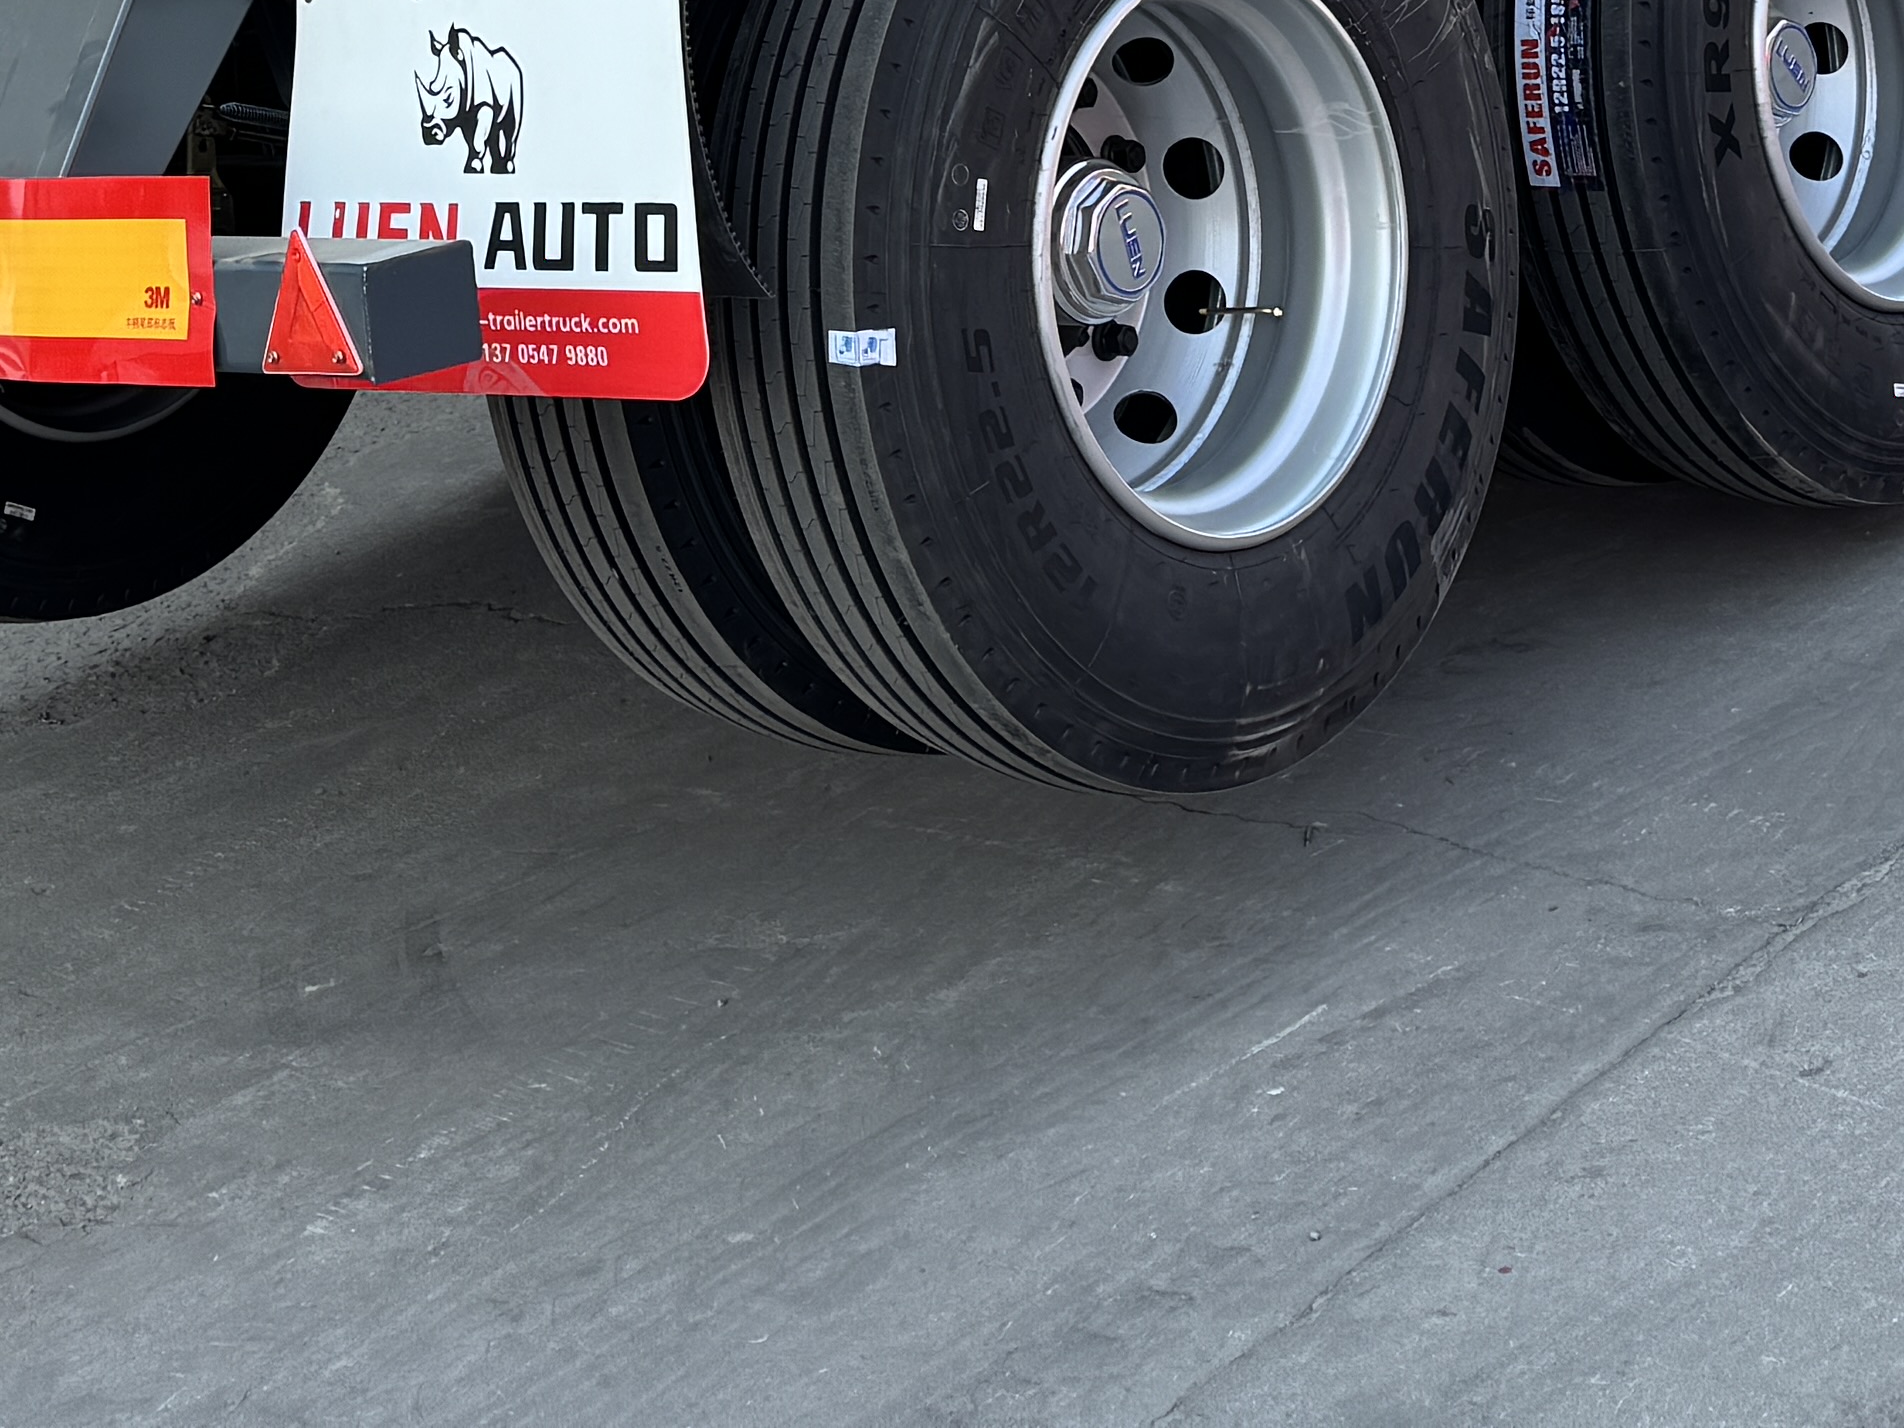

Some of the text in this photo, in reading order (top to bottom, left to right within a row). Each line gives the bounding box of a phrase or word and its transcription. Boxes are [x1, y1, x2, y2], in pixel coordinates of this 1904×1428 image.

[1775, 37, 1811, 93] LUEN
[1520, 39, 1552, 177] SAFERUN
[483, 201, 679, 272] AUTO
[1114, 197, 1147, 280] LUEN
[143, 286, 171, 309] 3M
[478, 308, 640, 335] -trailertruck.com
[482, 343, 608, 367] 137 0547 9880
[1345, 202, 1496, 645] SAFERUN
